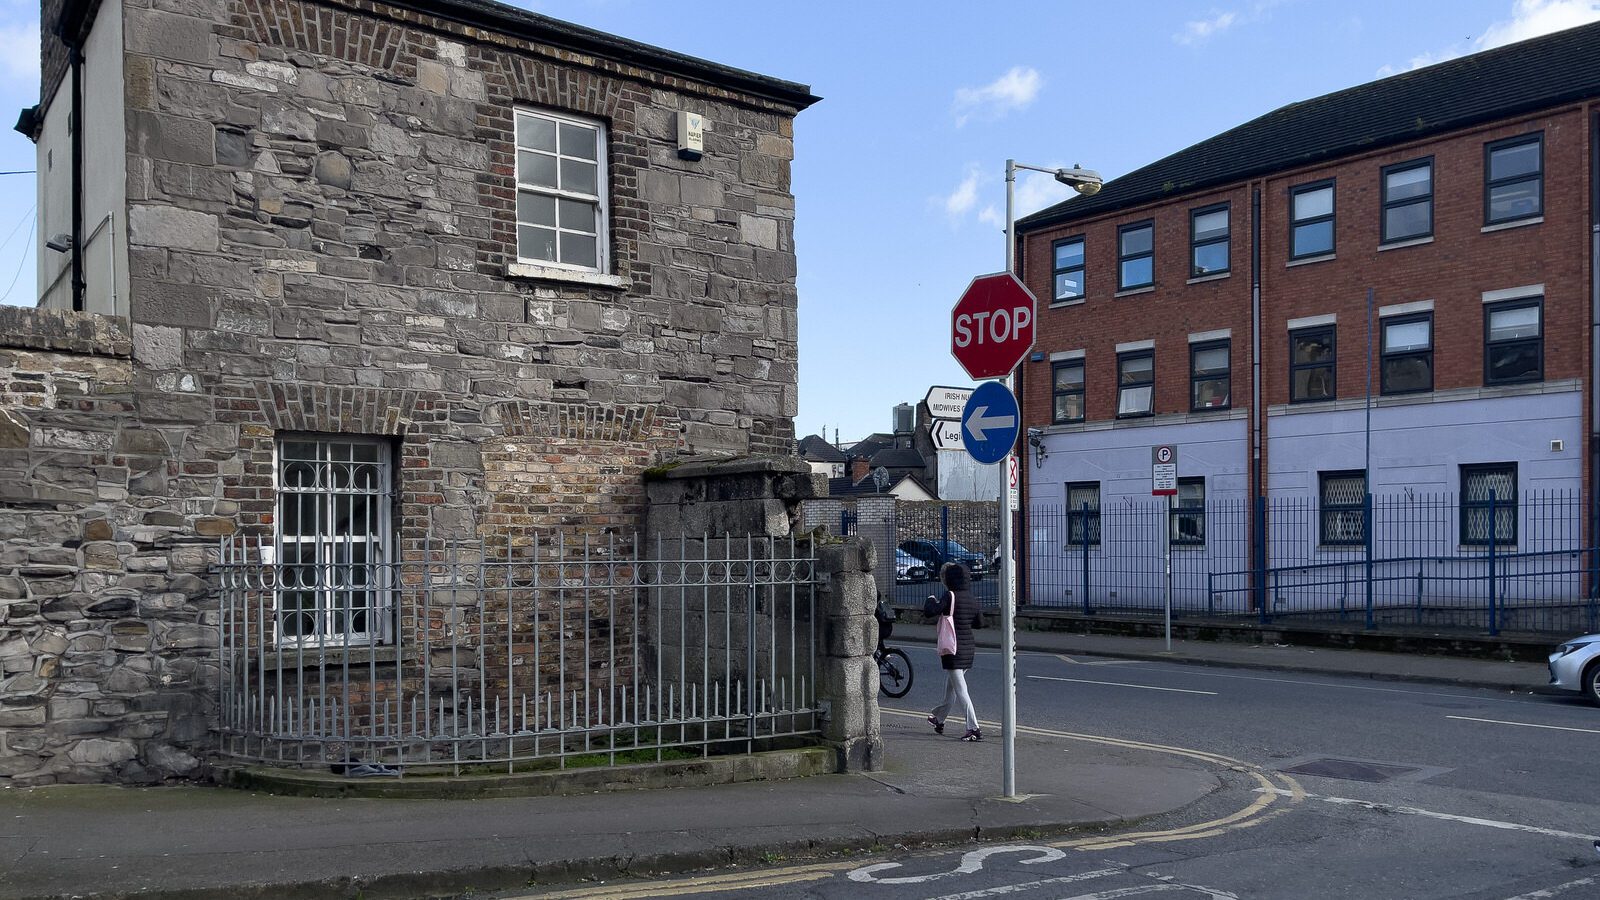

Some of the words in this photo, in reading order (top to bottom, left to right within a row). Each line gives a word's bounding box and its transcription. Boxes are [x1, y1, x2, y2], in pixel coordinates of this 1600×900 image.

[955, 306, 1031, 348] STOP
[945, 392, 960, 400] IRISH
[933, 404, 960, 412] MIDWIVES
[945, 430, 962, 441] Legi
[1162, 450, 1168, 460] P
